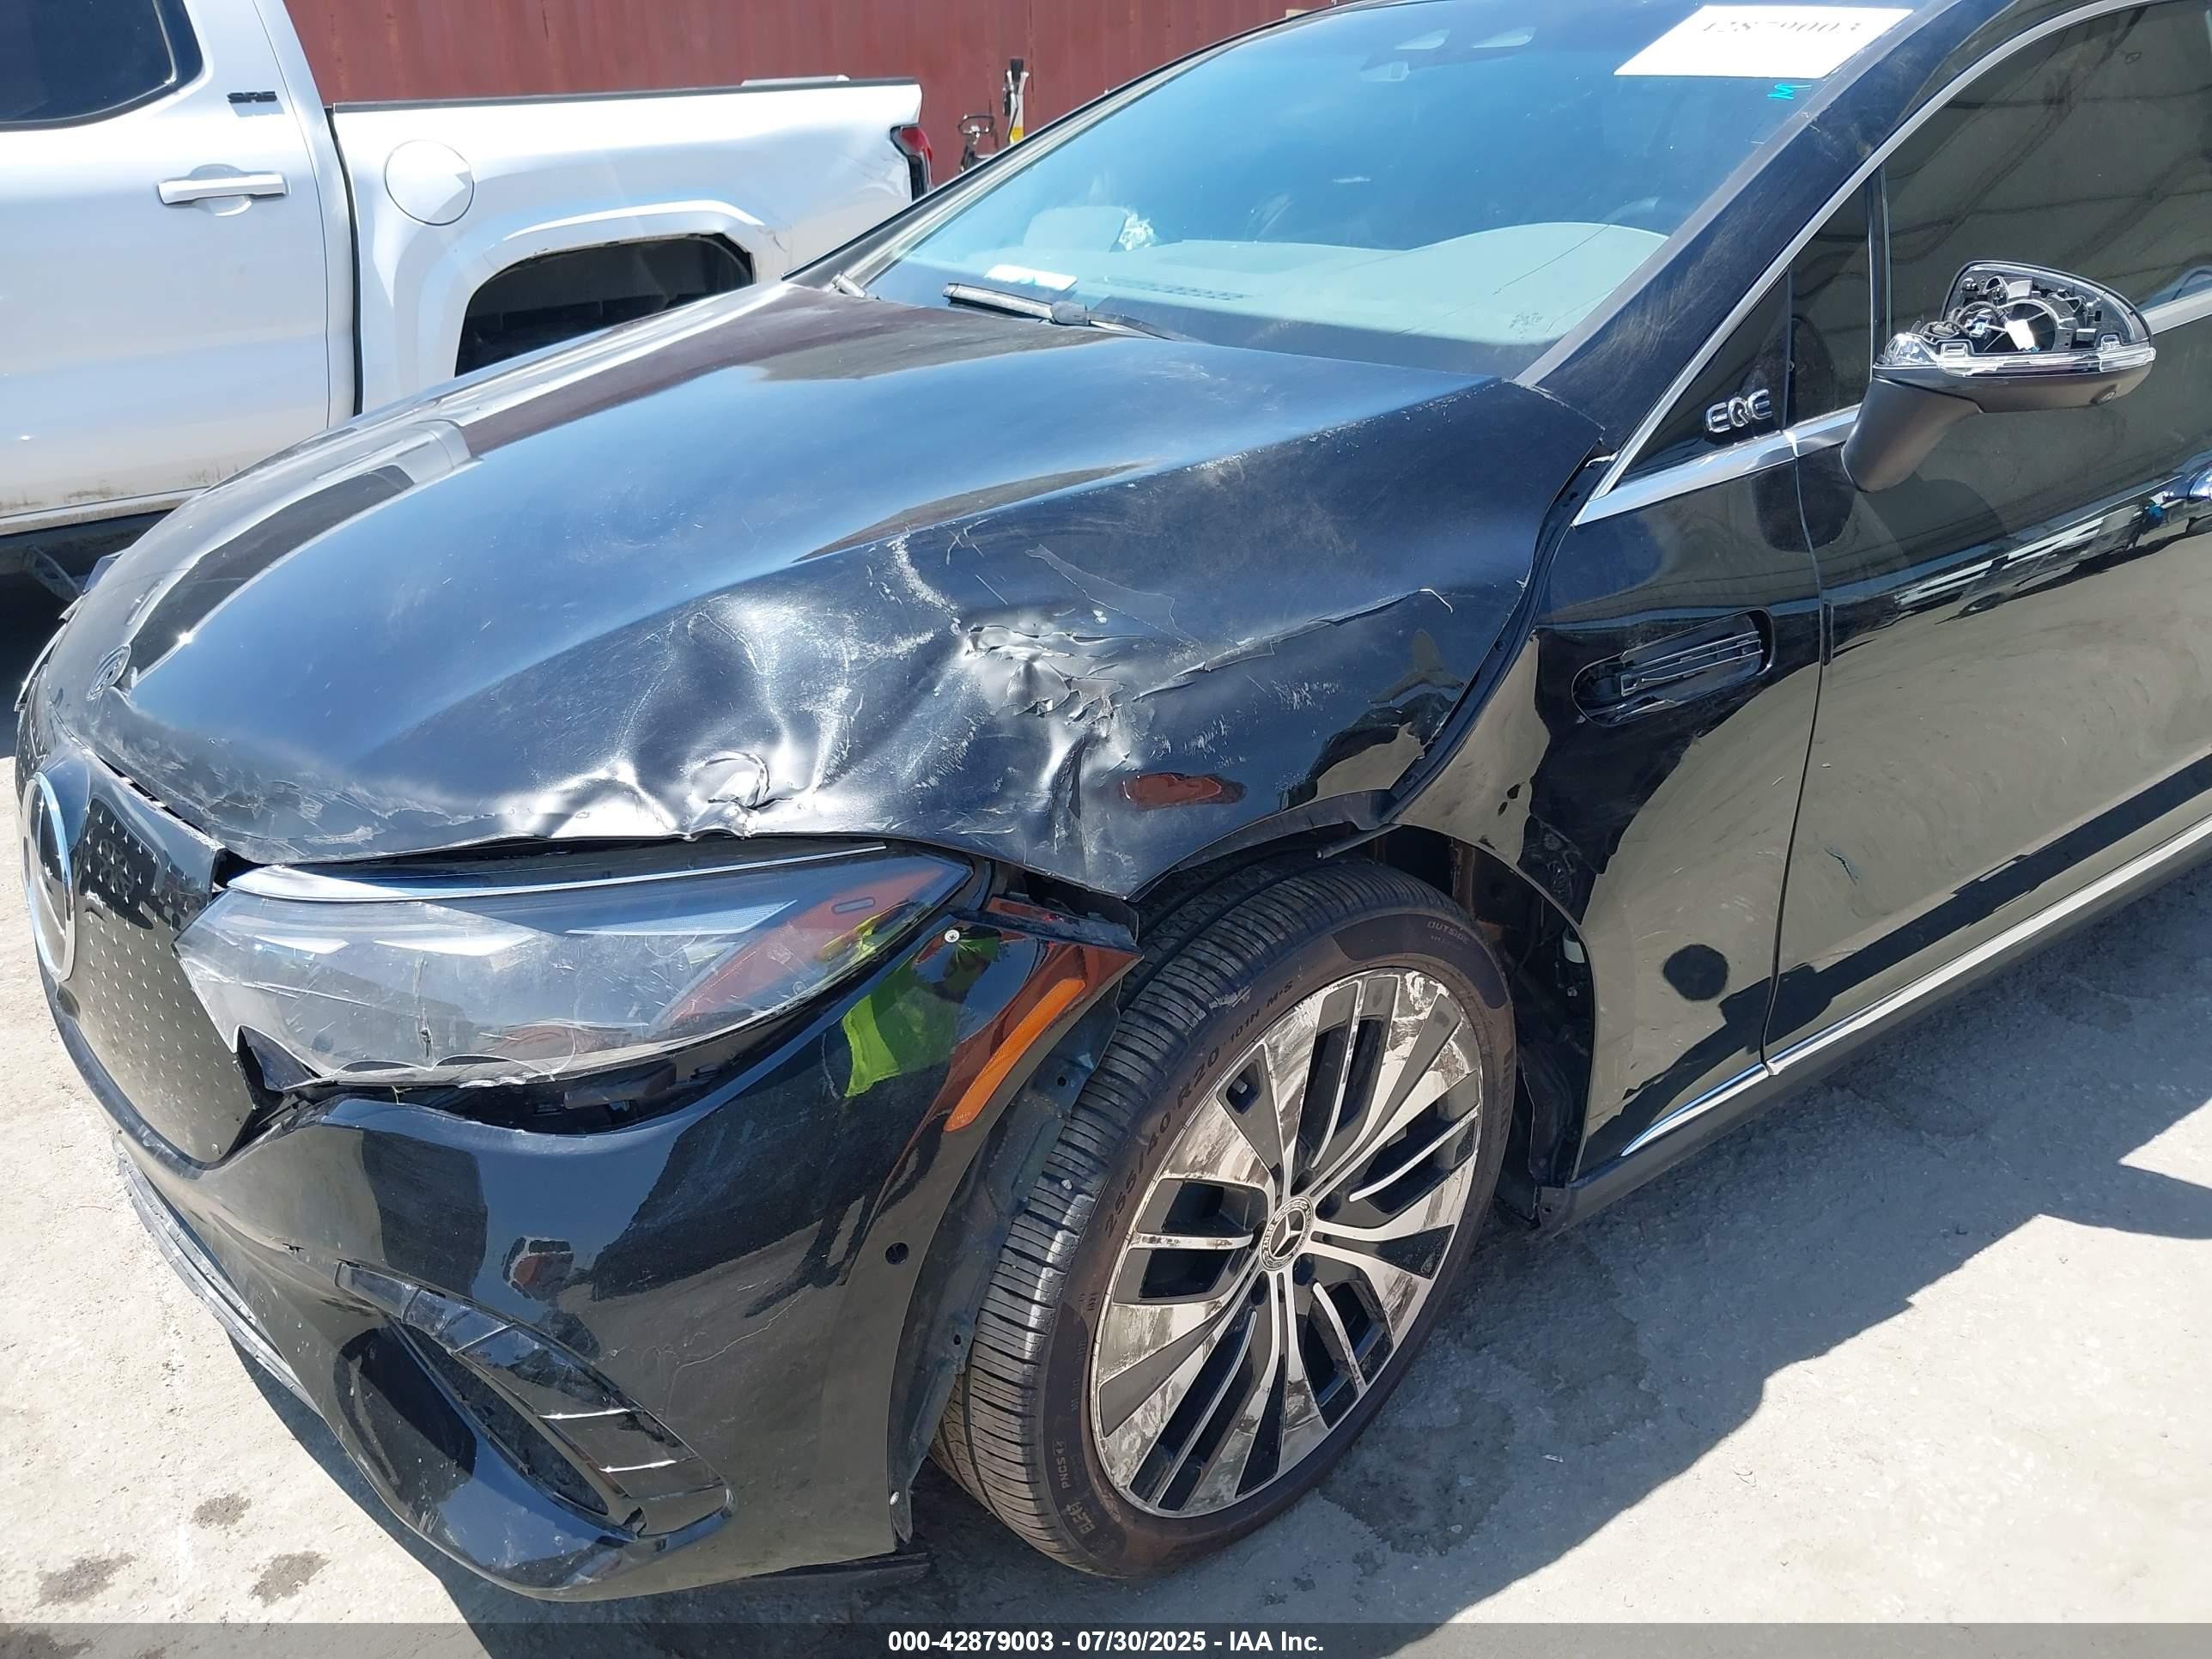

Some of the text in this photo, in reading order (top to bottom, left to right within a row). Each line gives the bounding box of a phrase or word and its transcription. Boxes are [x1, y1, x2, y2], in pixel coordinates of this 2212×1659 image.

[1705, 389, 1772, 433] EQE
[1104, 1111, 1171, 1239] 255/40
[1177, 1046, 1219, 1109] R20
[1230, 1008, 1260, 1044] 101H
[1261, 1223, 1275, 1250] BENZ
